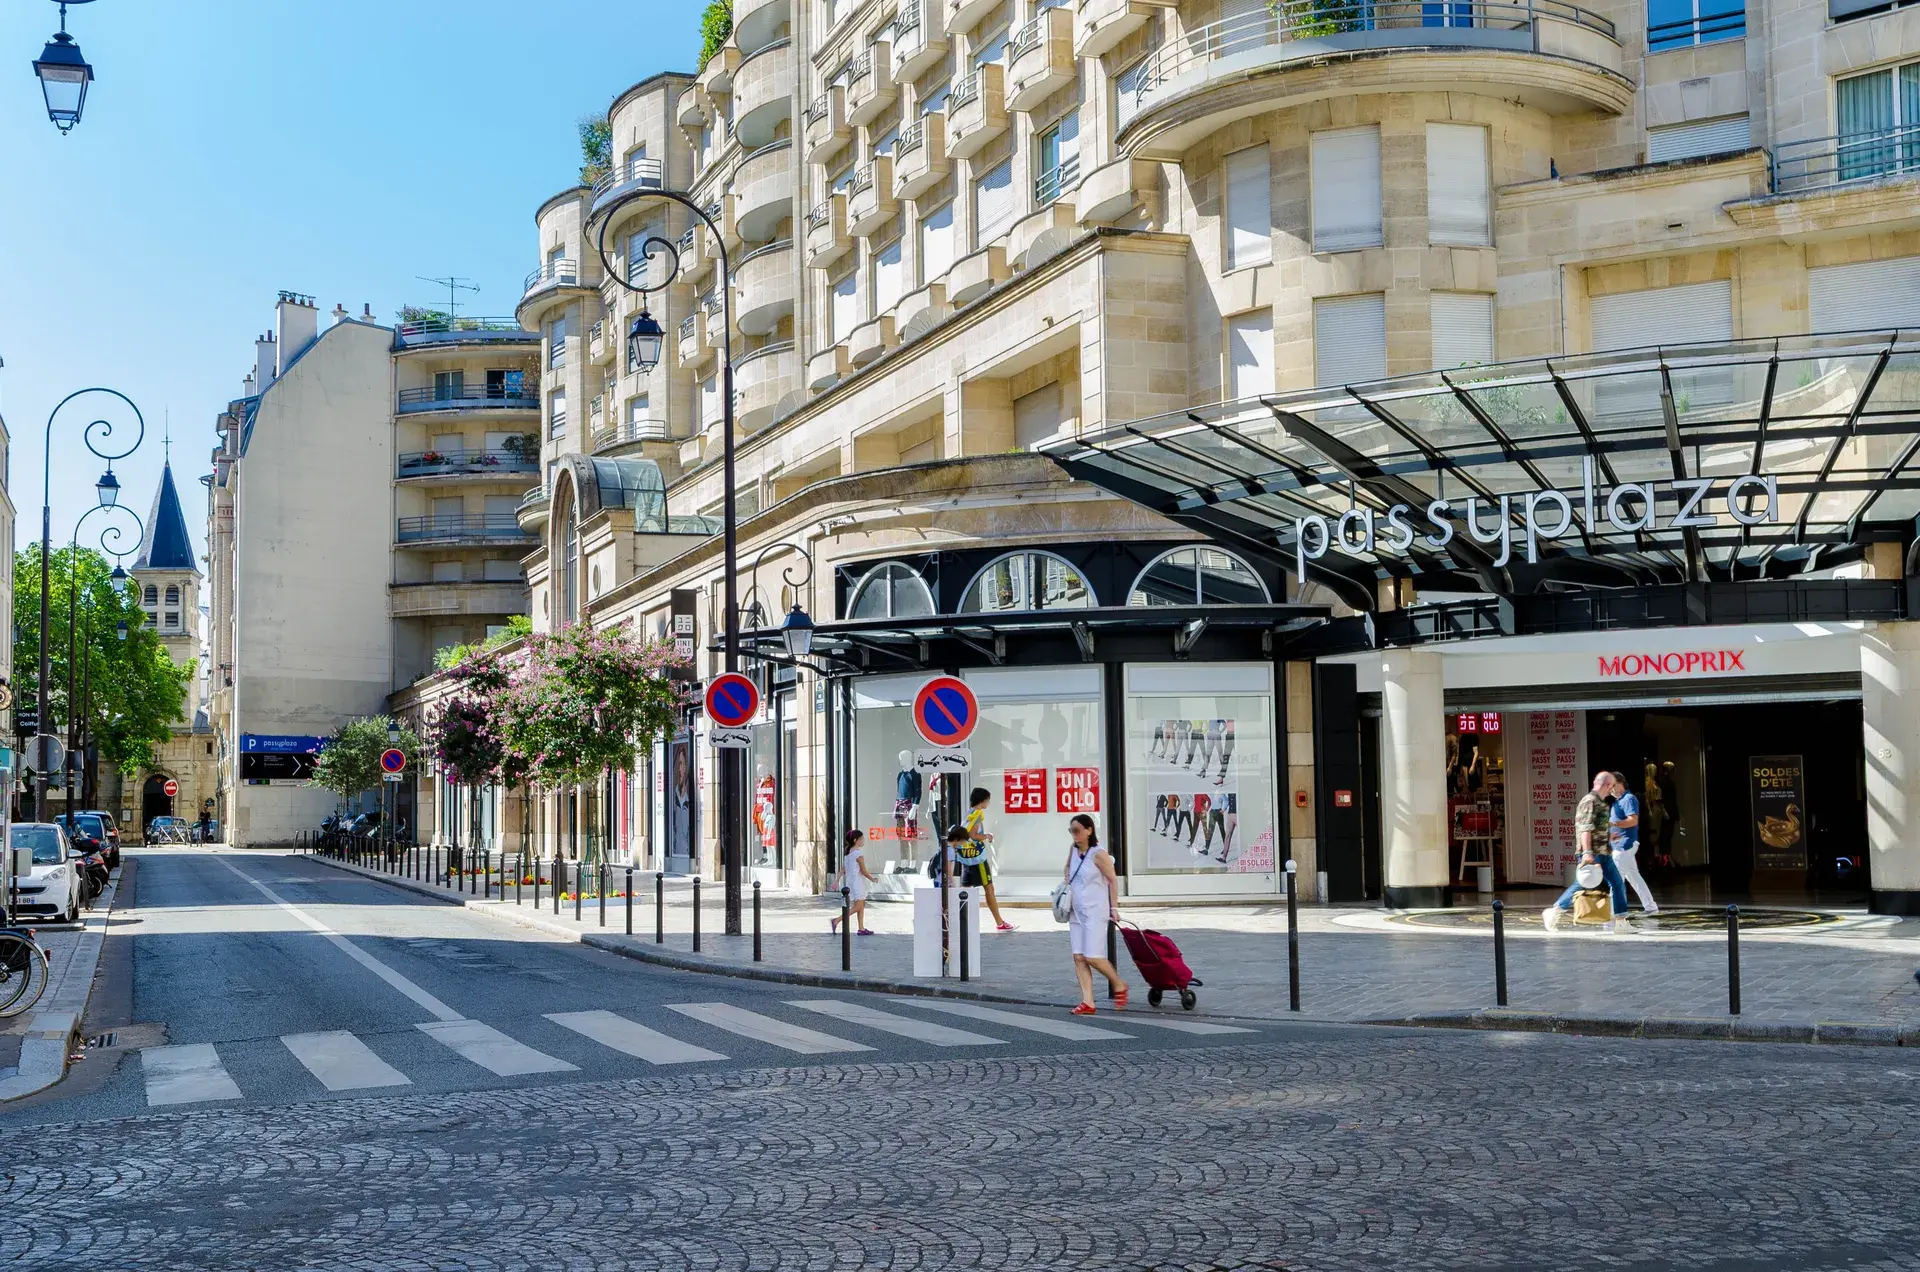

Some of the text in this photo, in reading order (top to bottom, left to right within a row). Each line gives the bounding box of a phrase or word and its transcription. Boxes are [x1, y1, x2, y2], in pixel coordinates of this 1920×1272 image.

[1296, 455, 1778, 583] passyplaza
[1598, 650, 1745, 676] MONOPRIX
[1484, 720, 1499, 732] QLO
[249, 738, 298, 750] P passyplaza
[1878, 748, 1892, 758] 53
[1753, 768, 1800, 777] SOLDES
[1010, 774, 1041, 790] ユニ
[1061, 773, 1092, 789] UNI
[1009, 792, 1042, 808] クロ
[1062, 792, 1095, 810] QLO
[870, 828, 886, 840] EZY
